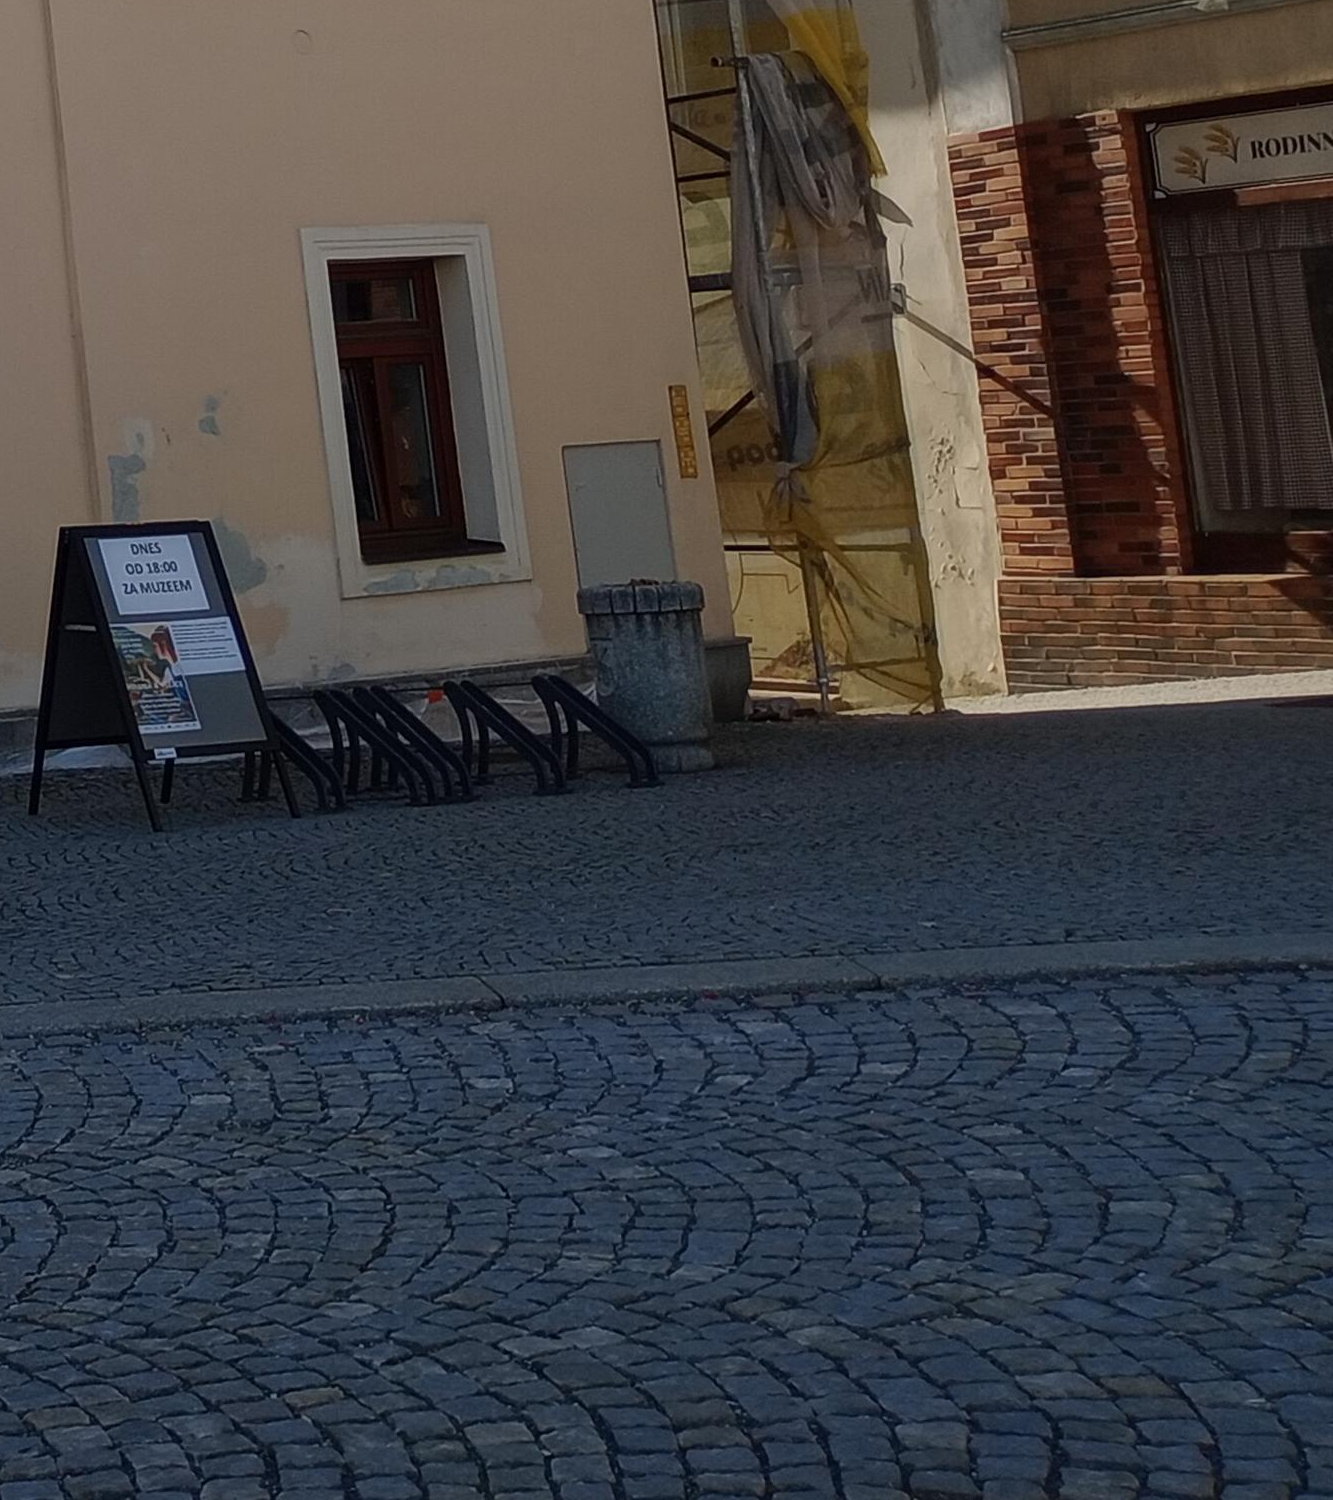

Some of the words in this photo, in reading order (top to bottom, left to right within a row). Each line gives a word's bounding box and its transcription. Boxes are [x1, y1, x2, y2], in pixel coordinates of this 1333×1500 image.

[130, 542, 162, 555] DNES
[125, 562, 144, 575] OD
[146, 561, 178, 574] 18:00
[122, 582, 139, 596] ZA
[140, 580, 193, 594] MUZEEM
